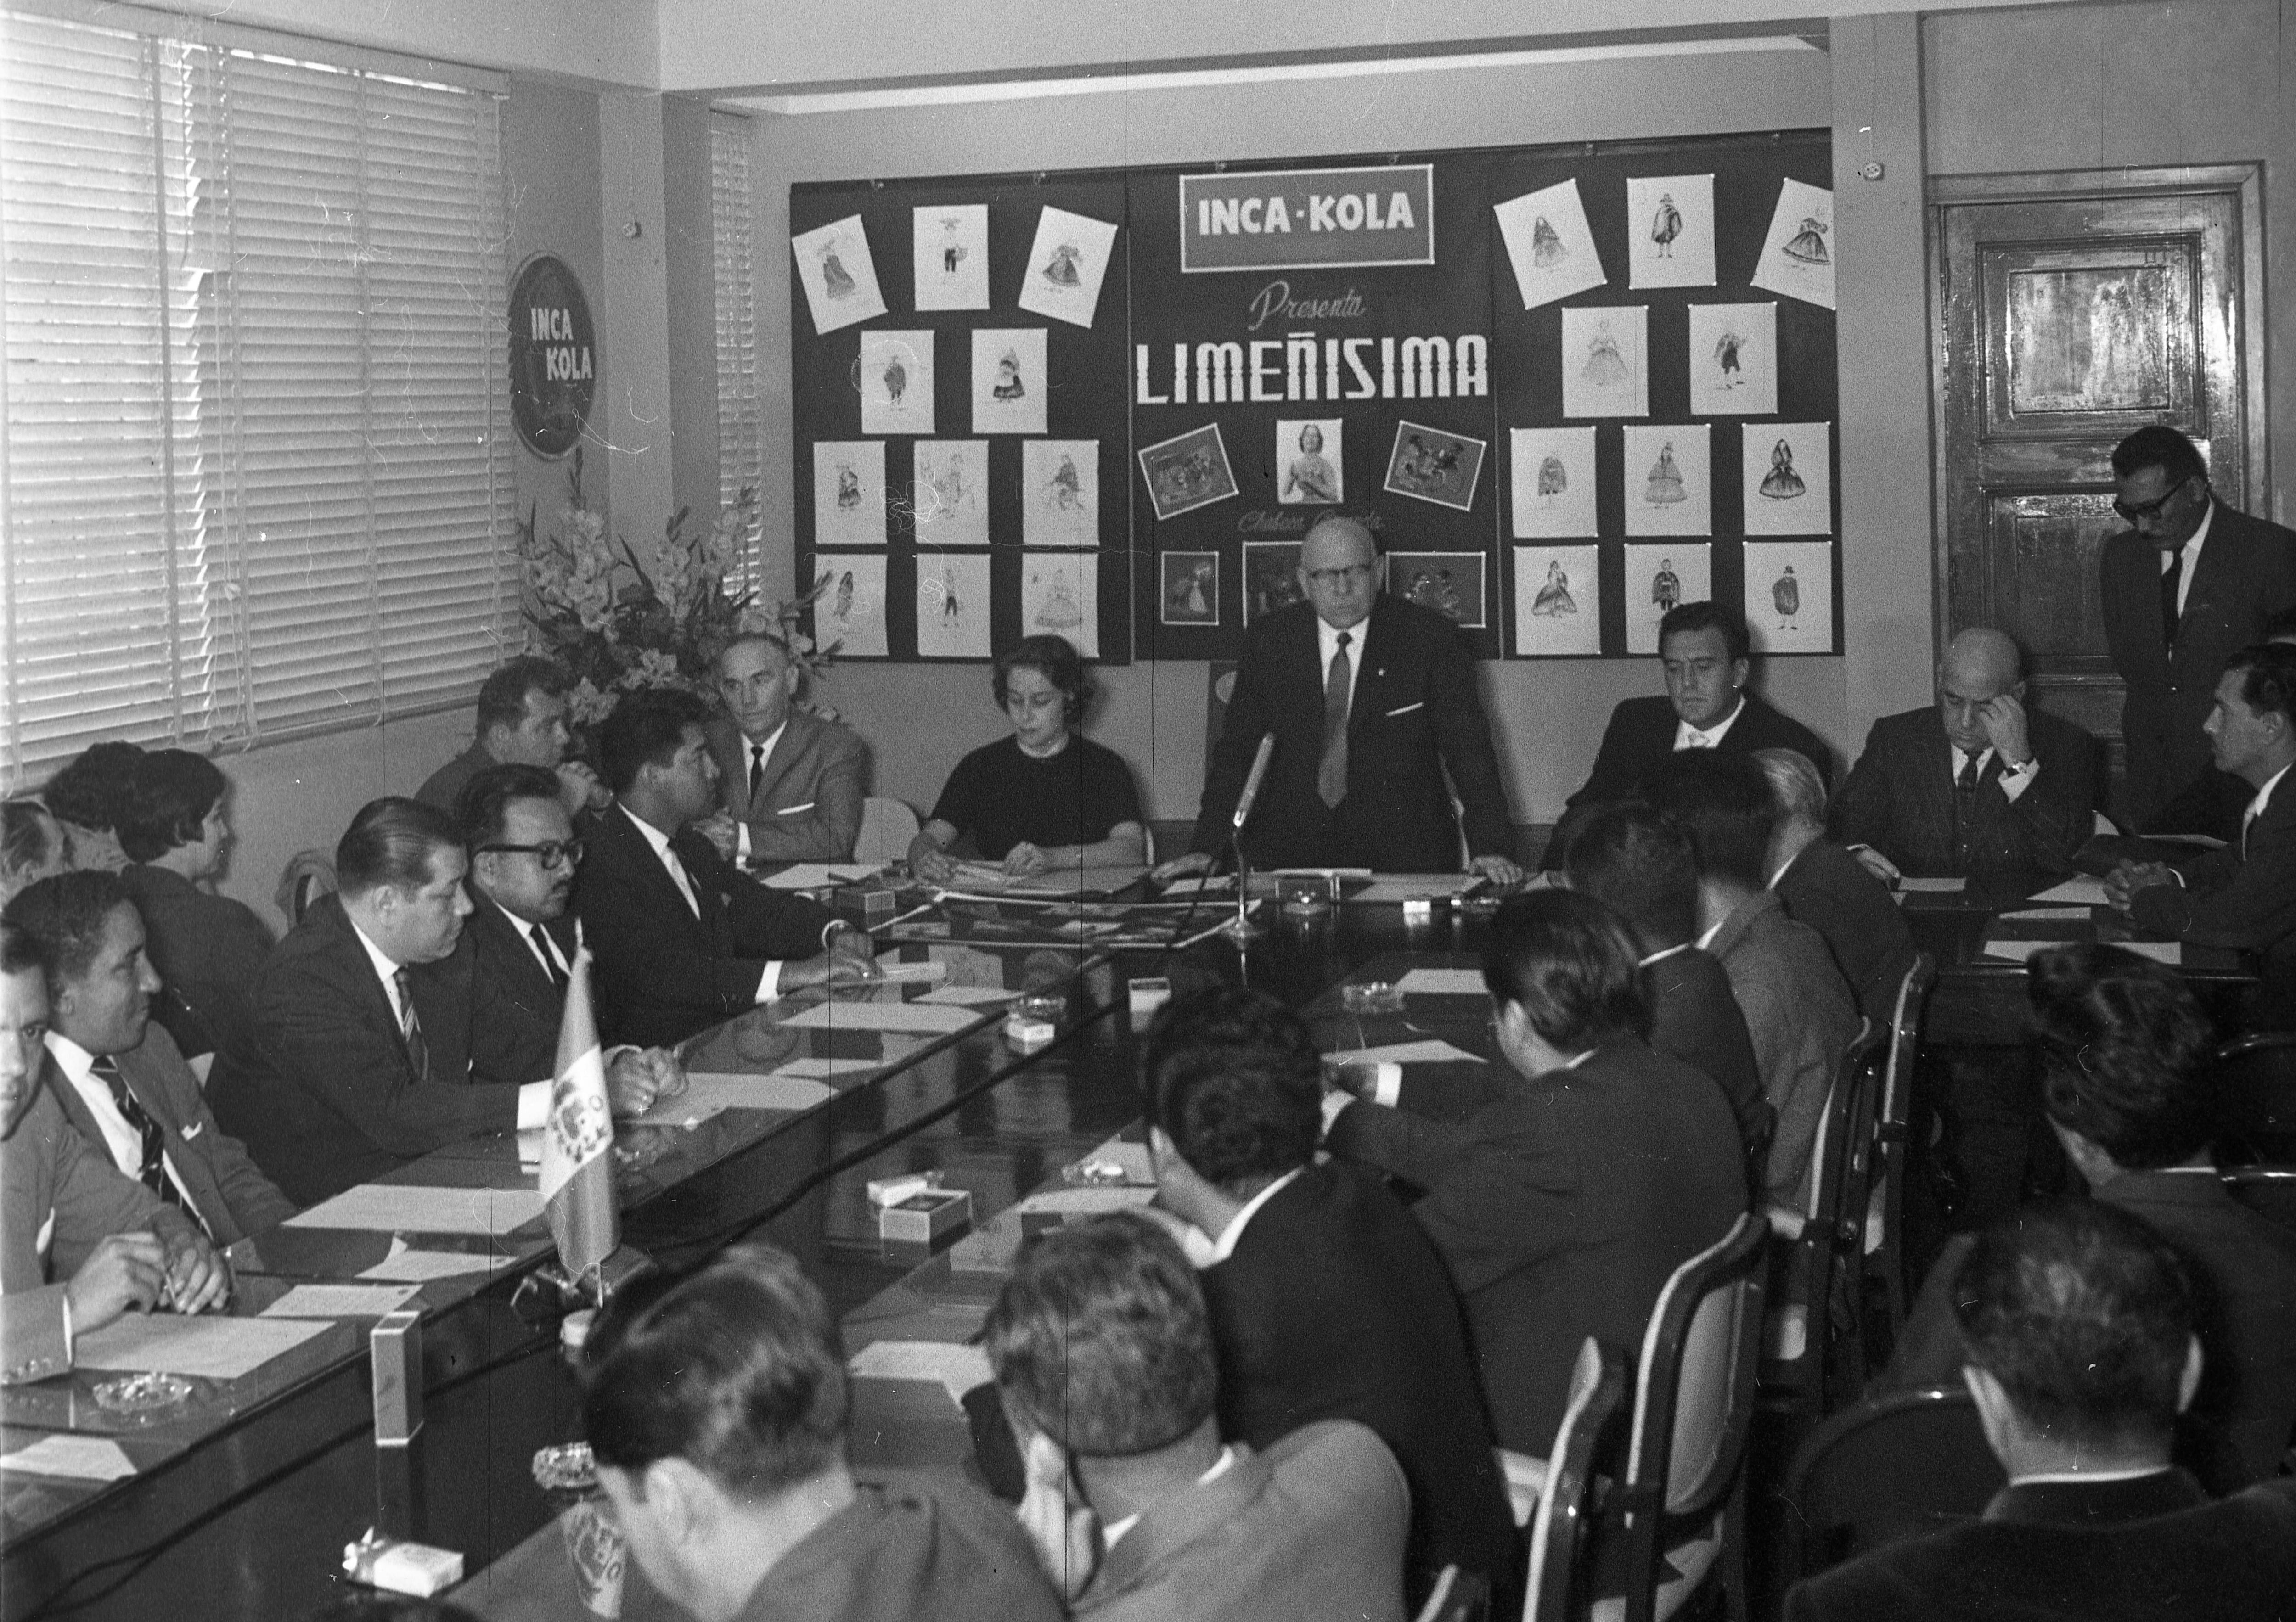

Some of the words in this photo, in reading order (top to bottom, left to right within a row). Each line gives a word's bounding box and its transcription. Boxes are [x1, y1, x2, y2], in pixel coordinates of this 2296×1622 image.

[1249, 281, 1367, 331] Presenta
[531, 308, 574, 340] INCA
[547, 347, 592, 380] KOLA
